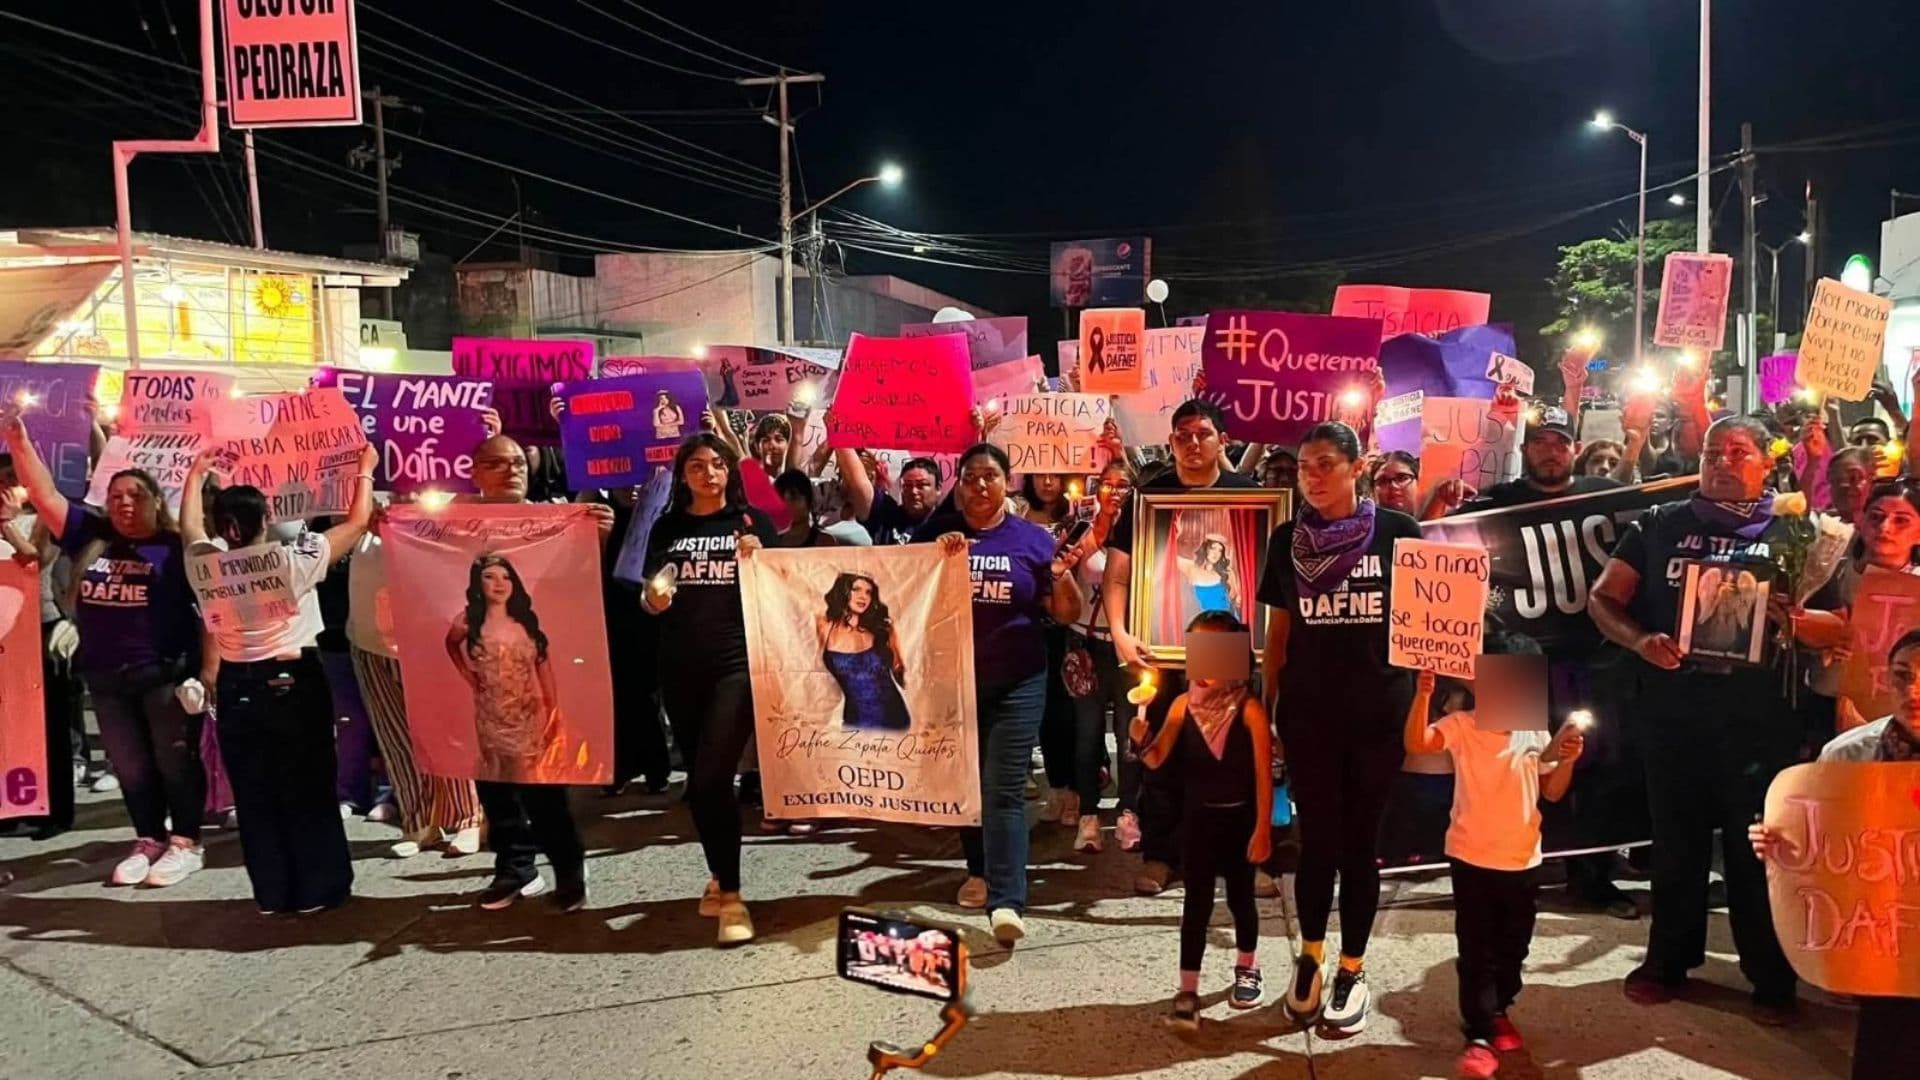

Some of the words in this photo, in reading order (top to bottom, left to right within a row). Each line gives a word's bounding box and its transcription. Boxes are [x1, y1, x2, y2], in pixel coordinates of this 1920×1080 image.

[234, 41, 345, 99] PEDRAZA
[1215, 315, 1379, 372] #Queremo
[128, 376, 195, 401] TODAS
[392, 380, 493, 411] MANTE
[260, 390, 321, 424] DAFNE
[393, 414, 444, 434] une
[1026, 420, 1068, 438] PARA
[287, 461, 309, 484] NO
[384, 438, 474, 482] Dafne
[668, 535, 735, 552] JUSTICIA
[691, 551, 708, 560] POR
[195, 562, 213, 582] LA
[250, 576, 285, 593] MATA
[80, 580, 149, 601] DAFNE
[1414, 576, 1451, 604] NO
[1391, 609, 1412, 628] se
[1421, 611, 1481, 643] tocan
[1391, 633, 1471, 659] queremos
[776, 728, 831, 760] Dafne
[896, 733, 957, 762] Quintos
[838, 764, 904, 791] QEPD
[783, 791, 875, 807] EXIGIMOS
[879, 796, 962, 815] JUSTICIA
